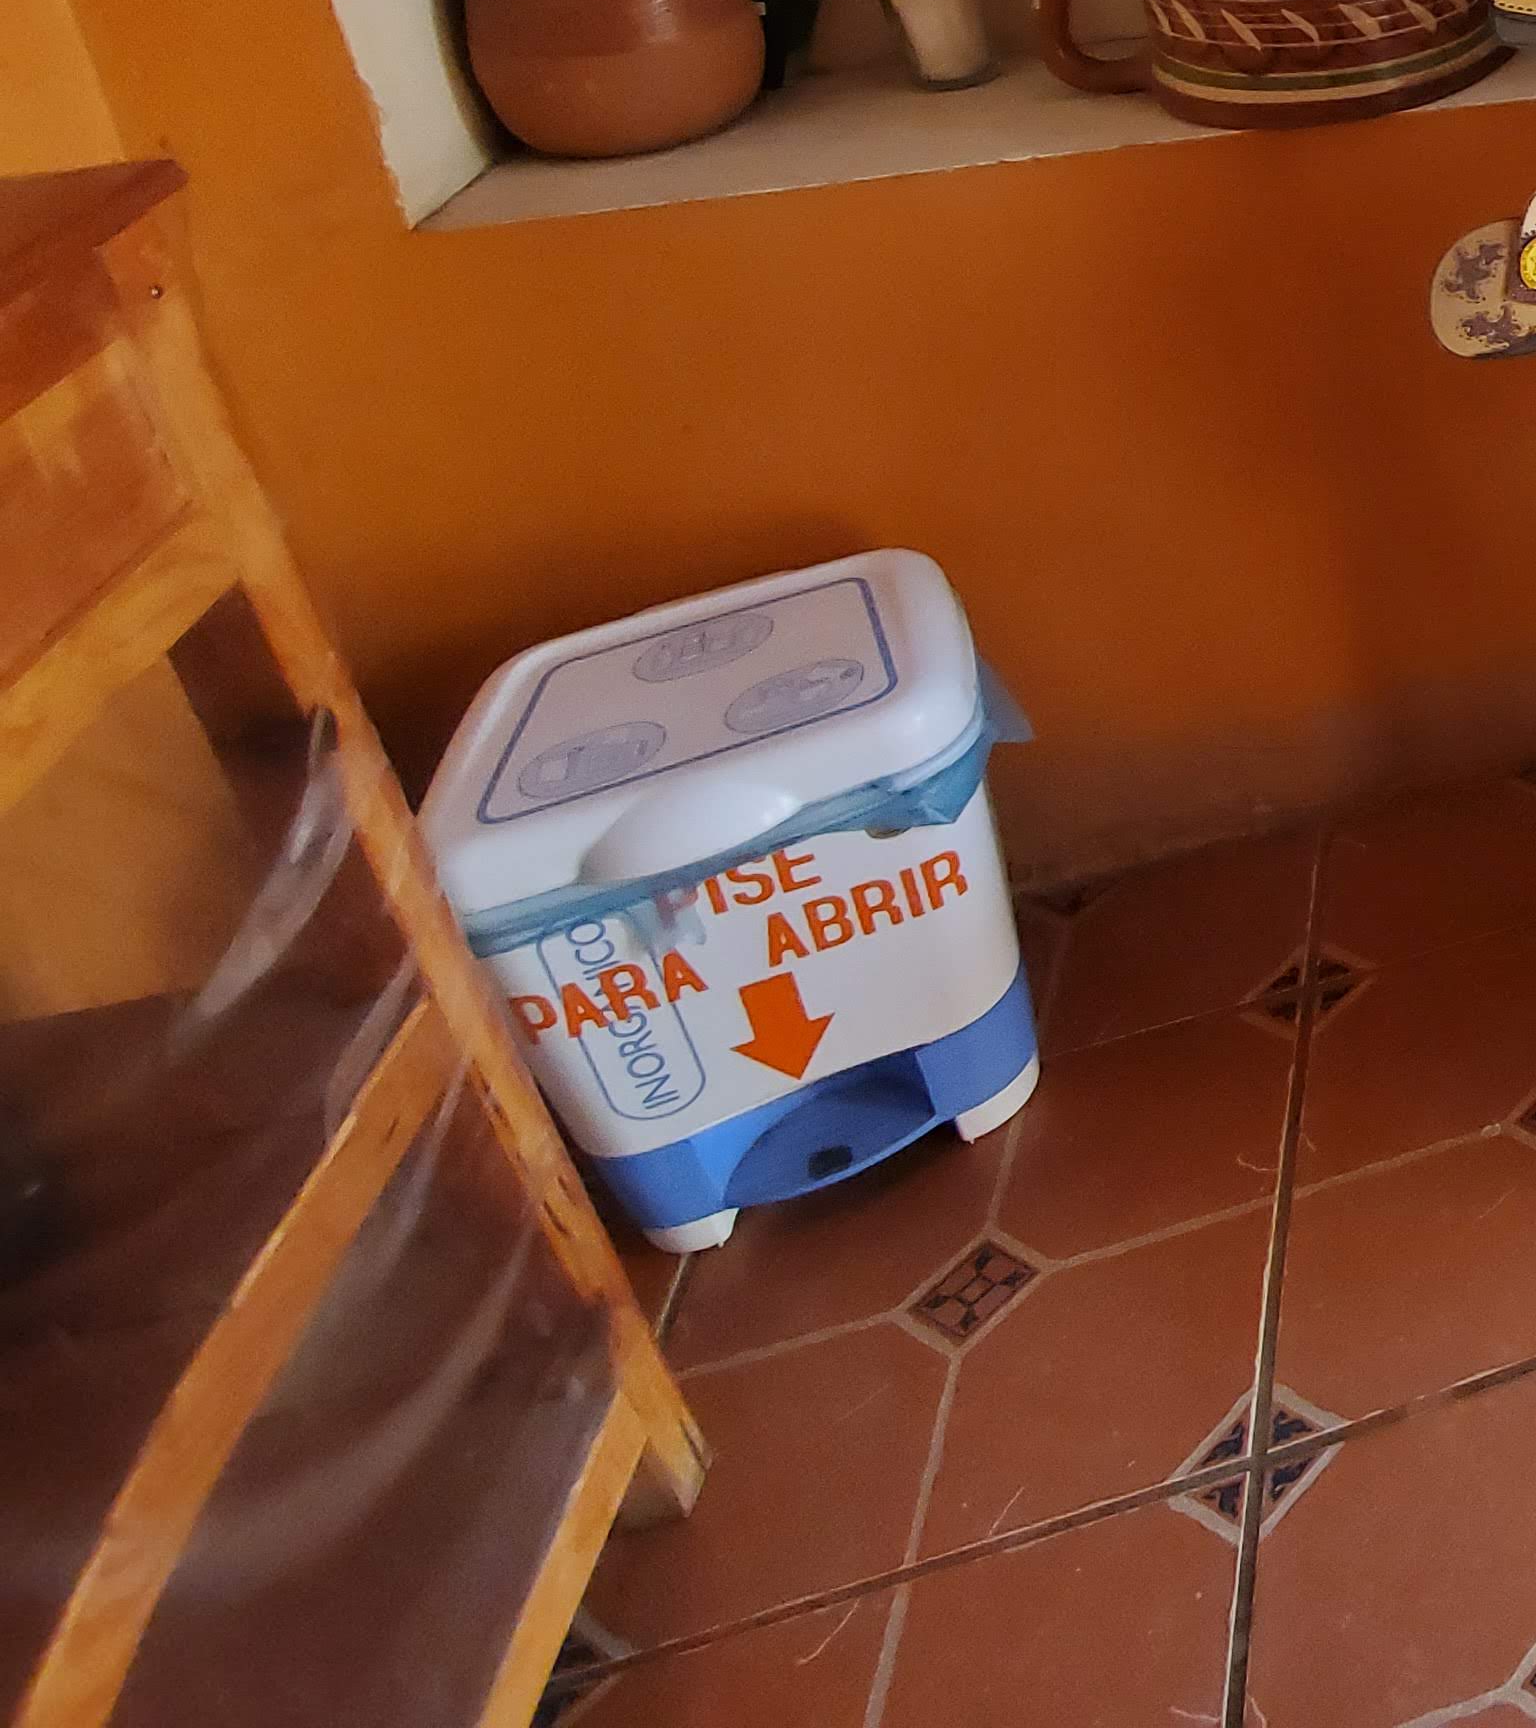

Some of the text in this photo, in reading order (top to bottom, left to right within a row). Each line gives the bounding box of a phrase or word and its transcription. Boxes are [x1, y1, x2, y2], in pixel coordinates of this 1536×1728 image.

[509, 851, 968, 1046] PARA ABRIR
[654, 849, 821, 929] PISE
